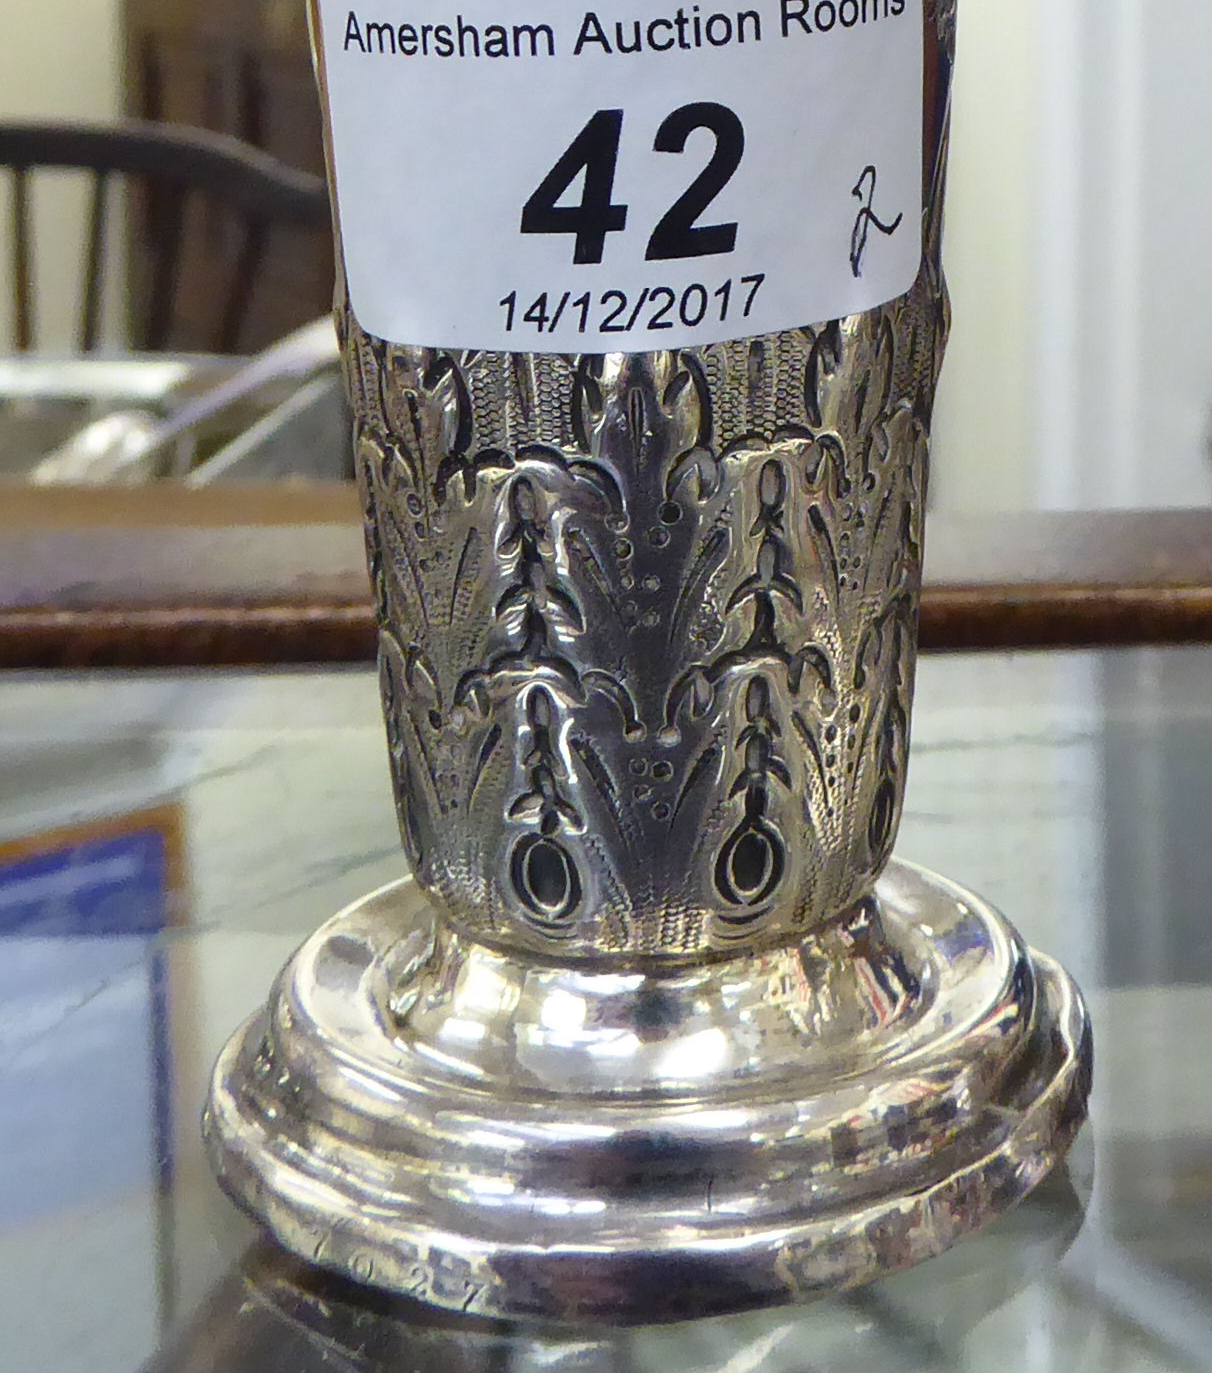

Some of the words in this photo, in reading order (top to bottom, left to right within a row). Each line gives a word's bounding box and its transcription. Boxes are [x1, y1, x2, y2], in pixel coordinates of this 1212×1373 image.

[343, 11, 555, 58] Amersham
[573, 5, 762, 56] Auction
[519, 101, 746, 265] 42
[499, 273, 767, 334] 14/12/2017
